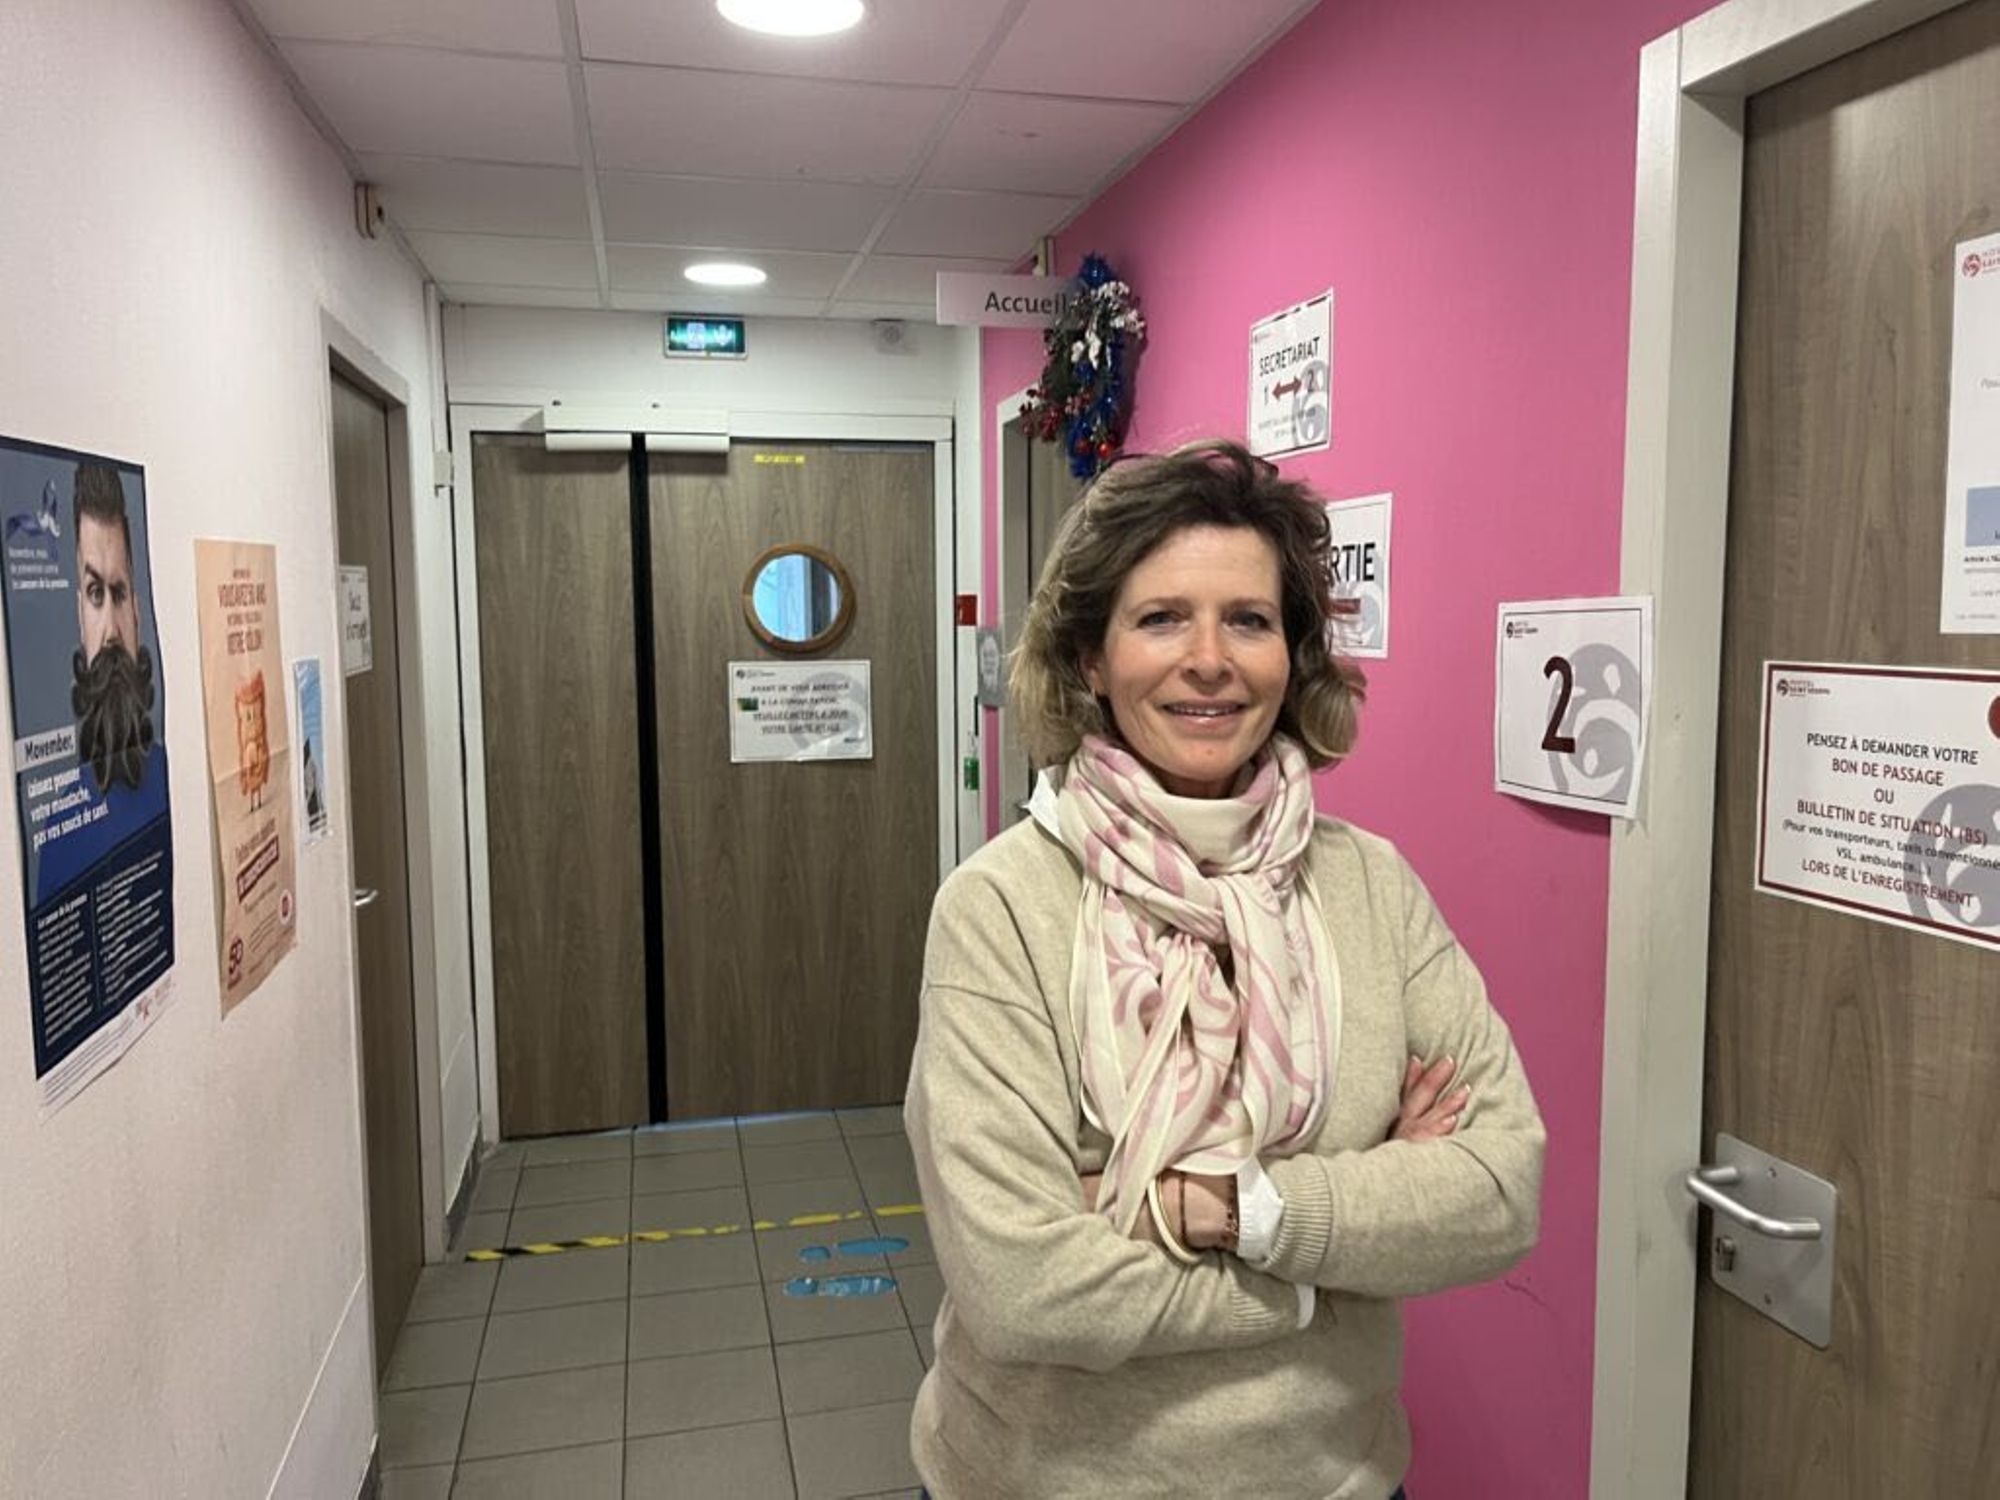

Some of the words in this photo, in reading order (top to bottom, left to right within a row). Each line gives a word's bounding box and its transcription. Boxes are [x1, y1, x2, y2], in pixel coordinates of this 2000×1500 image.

[985, 291, 1066, 314] Accueil
[1330, 543, 1376, 582] RTIE
[1541, 655, 1576, 754] 2
[1807, 733, 1847, 750] PENSEZ
[1862, 739, 1928, 759] DEMANDER
[1932, 746, 1979, 765] VOTRE
[1832, 758, 1857, 774] BON
[1862, 762, 1879, 778] DE
[1883, 764, 1944, 787] PASSAGE
[1874, 788, 1894, 804] OU
[1797, 799, 1855, 822] BULLETIN
[1859, 810, 1876, 827] DE
[1881, 814, 1953, 840] SITUATION
[1959, 826, 1988, 847] (BS)
[1808, 826, 1823, 836] vos
[1825, 827, 1894, 851] transporteurs,
[1925, 846, 2000, 870] conventionné
[1802, 858, 1830, 875] LORS
[1833, 864, 1848, 880] DE
[1851, 868, 1972, 907] L'ENREGISTREMENT
